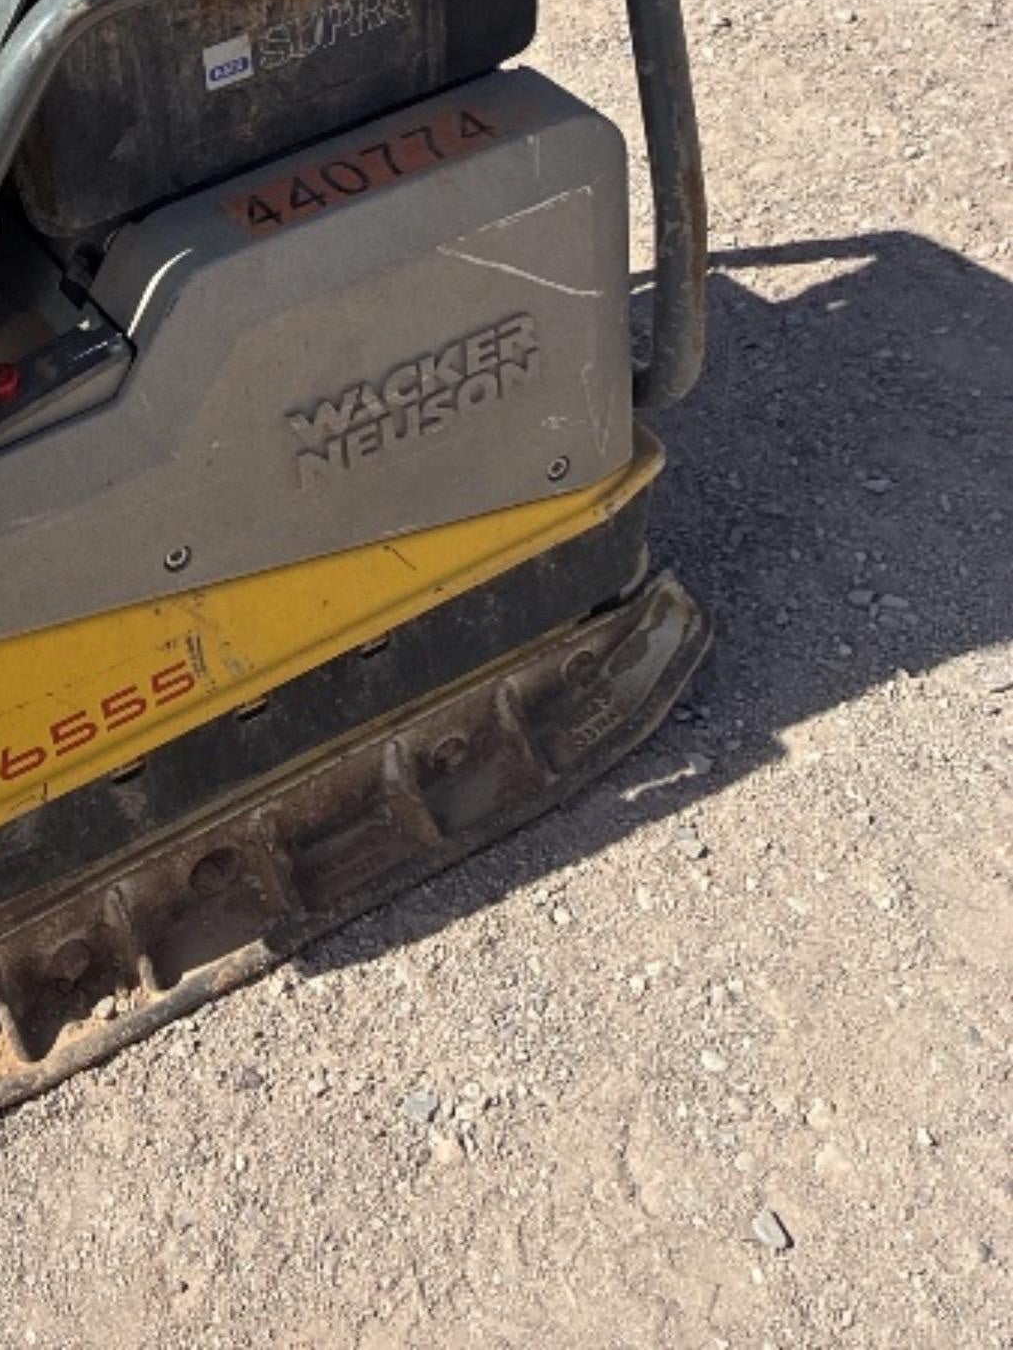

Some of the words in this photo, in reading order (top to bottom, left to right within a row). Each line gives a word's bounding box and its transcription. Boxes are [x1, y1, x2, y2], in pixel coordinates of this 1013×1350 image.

[246, 109, 498, 228] 440774
[284, 310, 539, 442] WACKER
[293, 350, 540, 492] NEUSON
